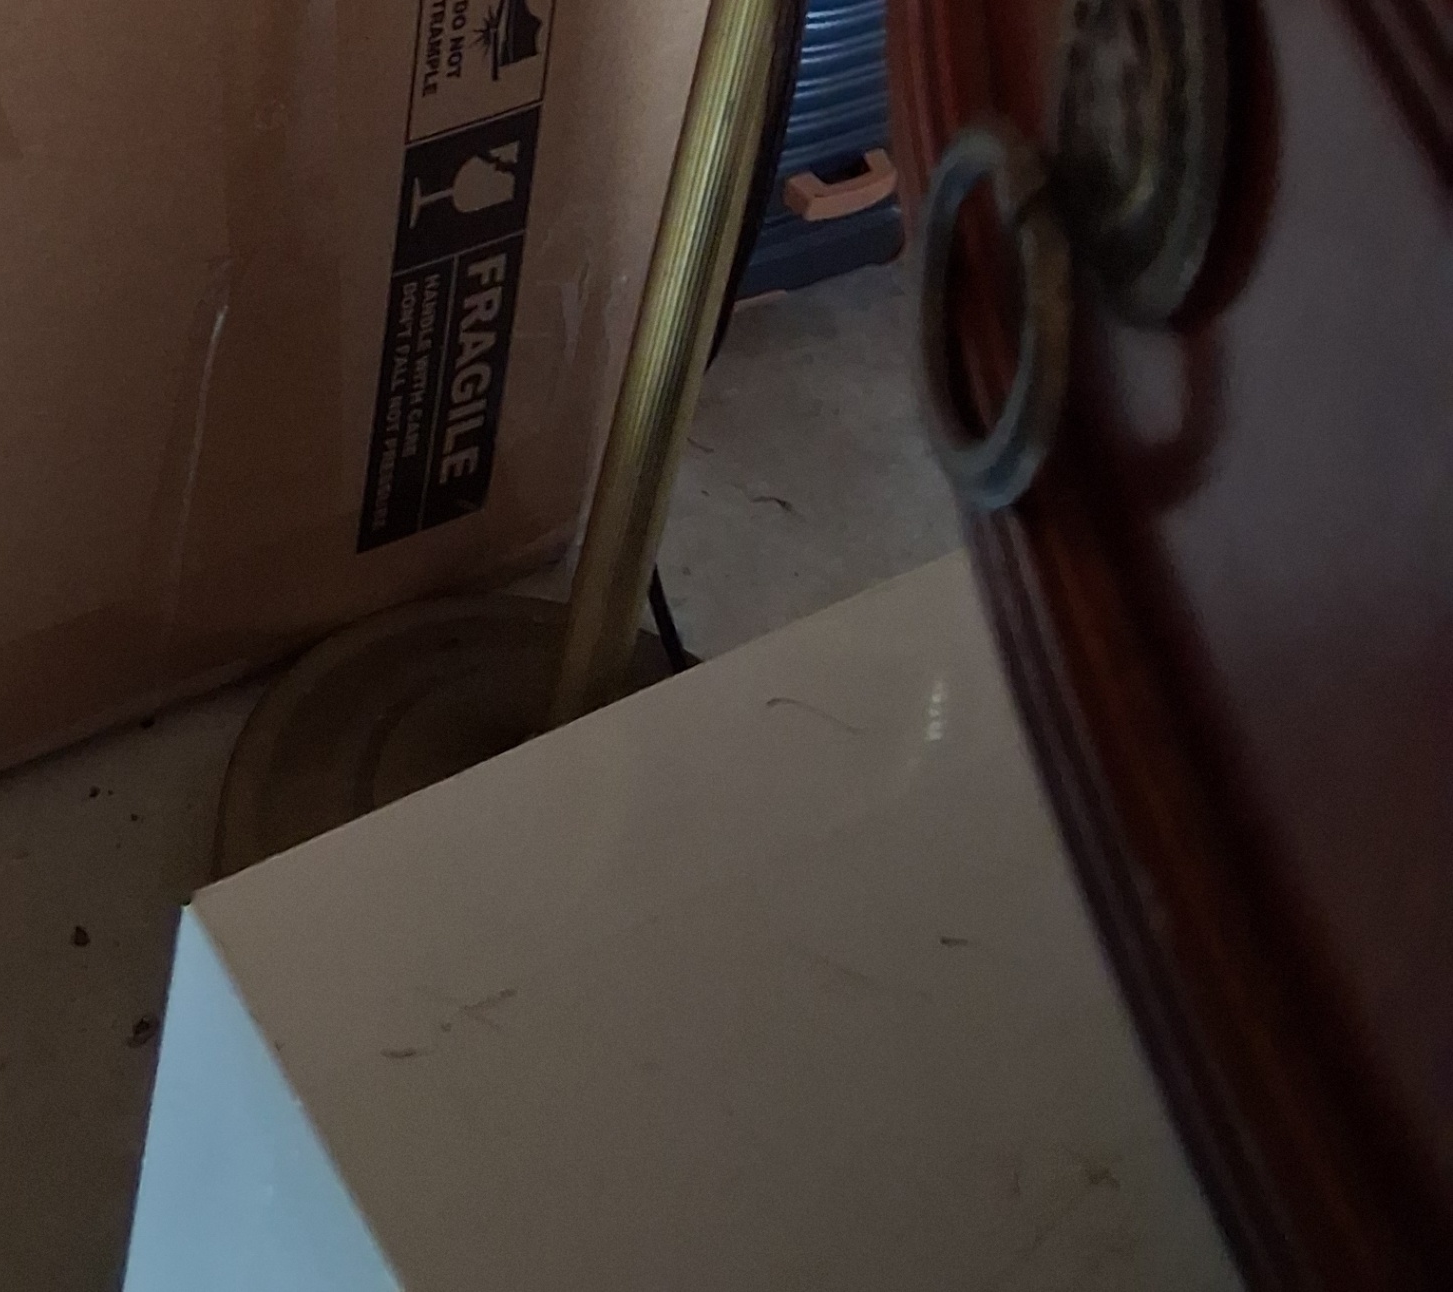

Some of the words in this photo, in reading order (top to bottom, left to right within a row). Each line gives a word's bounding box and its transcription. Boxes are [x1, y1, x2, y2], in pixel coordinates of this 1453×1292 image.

[452, 0, 470, 32] DO
[446, 35, 466, 78] NOT
[415, 274, 440, 353] HANDLE
[409, 355, 429, 405] WITH
[438, 252, 507, 486] FRAGILE
[402, 408, 423, 458] CARE
